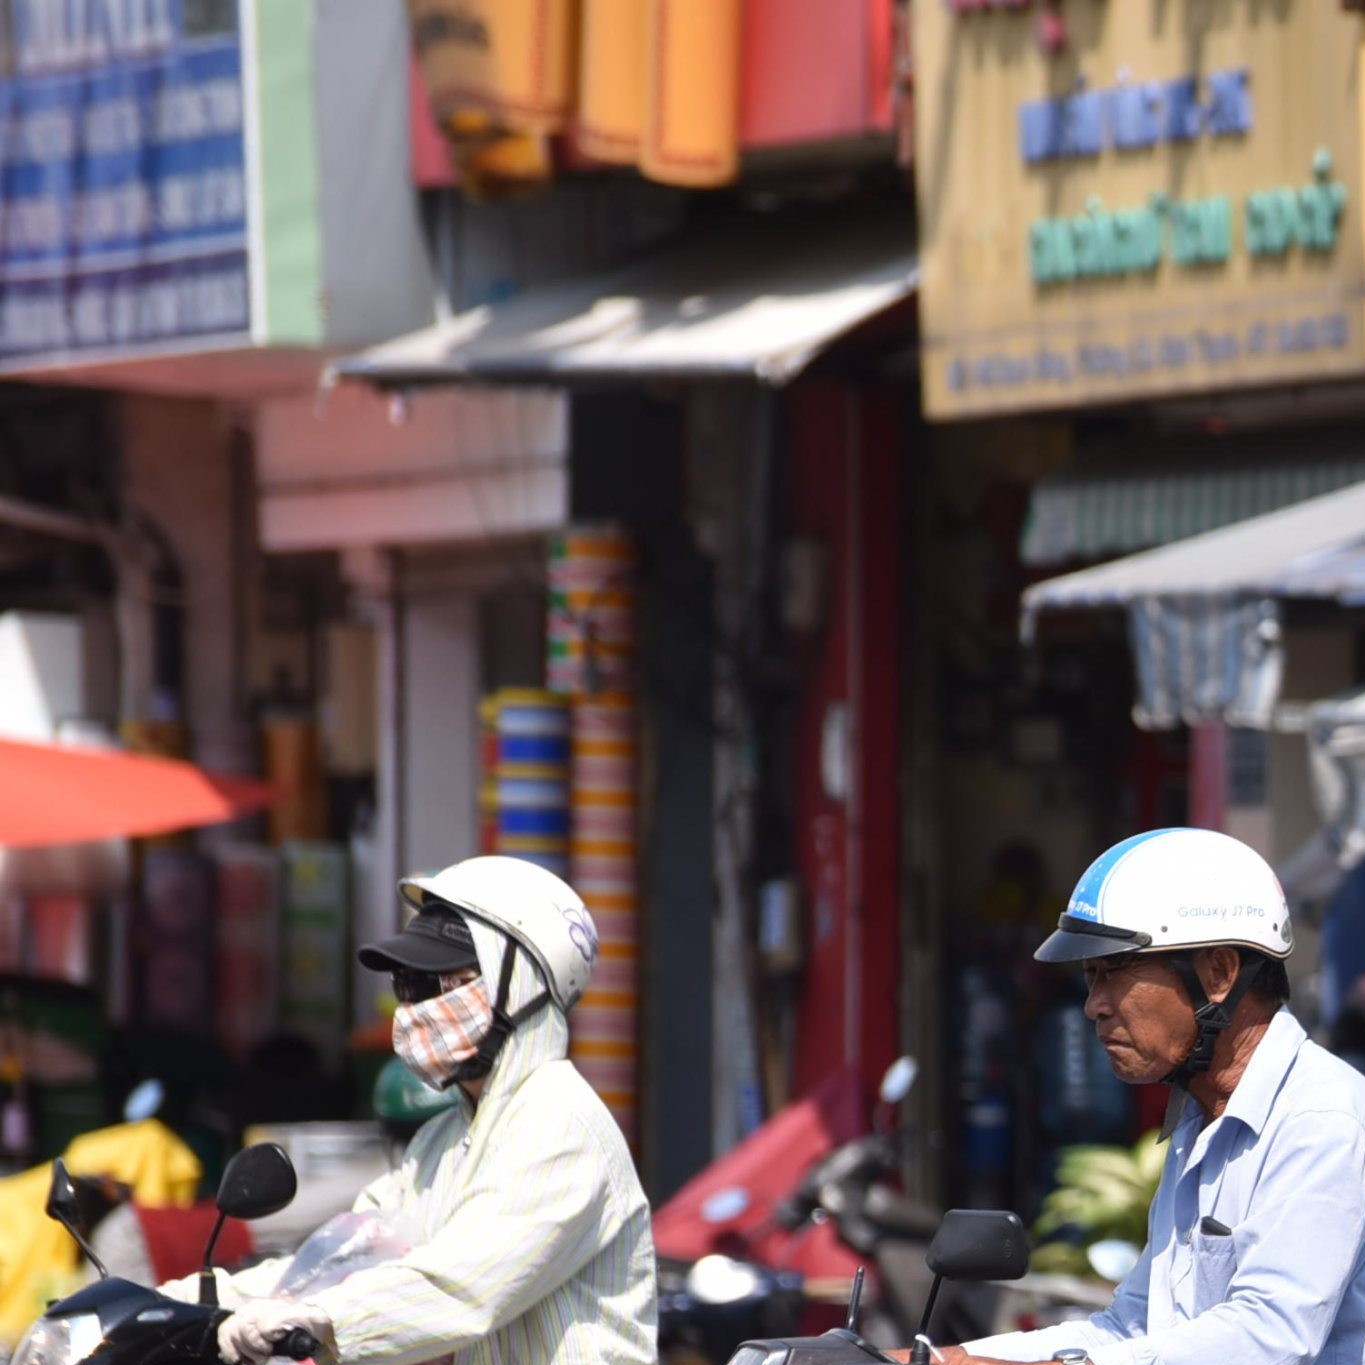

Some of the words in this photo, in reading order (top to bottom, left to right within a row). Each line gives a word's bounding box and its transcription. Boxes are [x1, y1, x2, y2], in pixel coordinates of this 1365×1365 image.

[1178, 905, 1228, 920] Galaxy
[1231, 905, 1244, 917] J7
[1246, 905, 1265, 917] Pro
